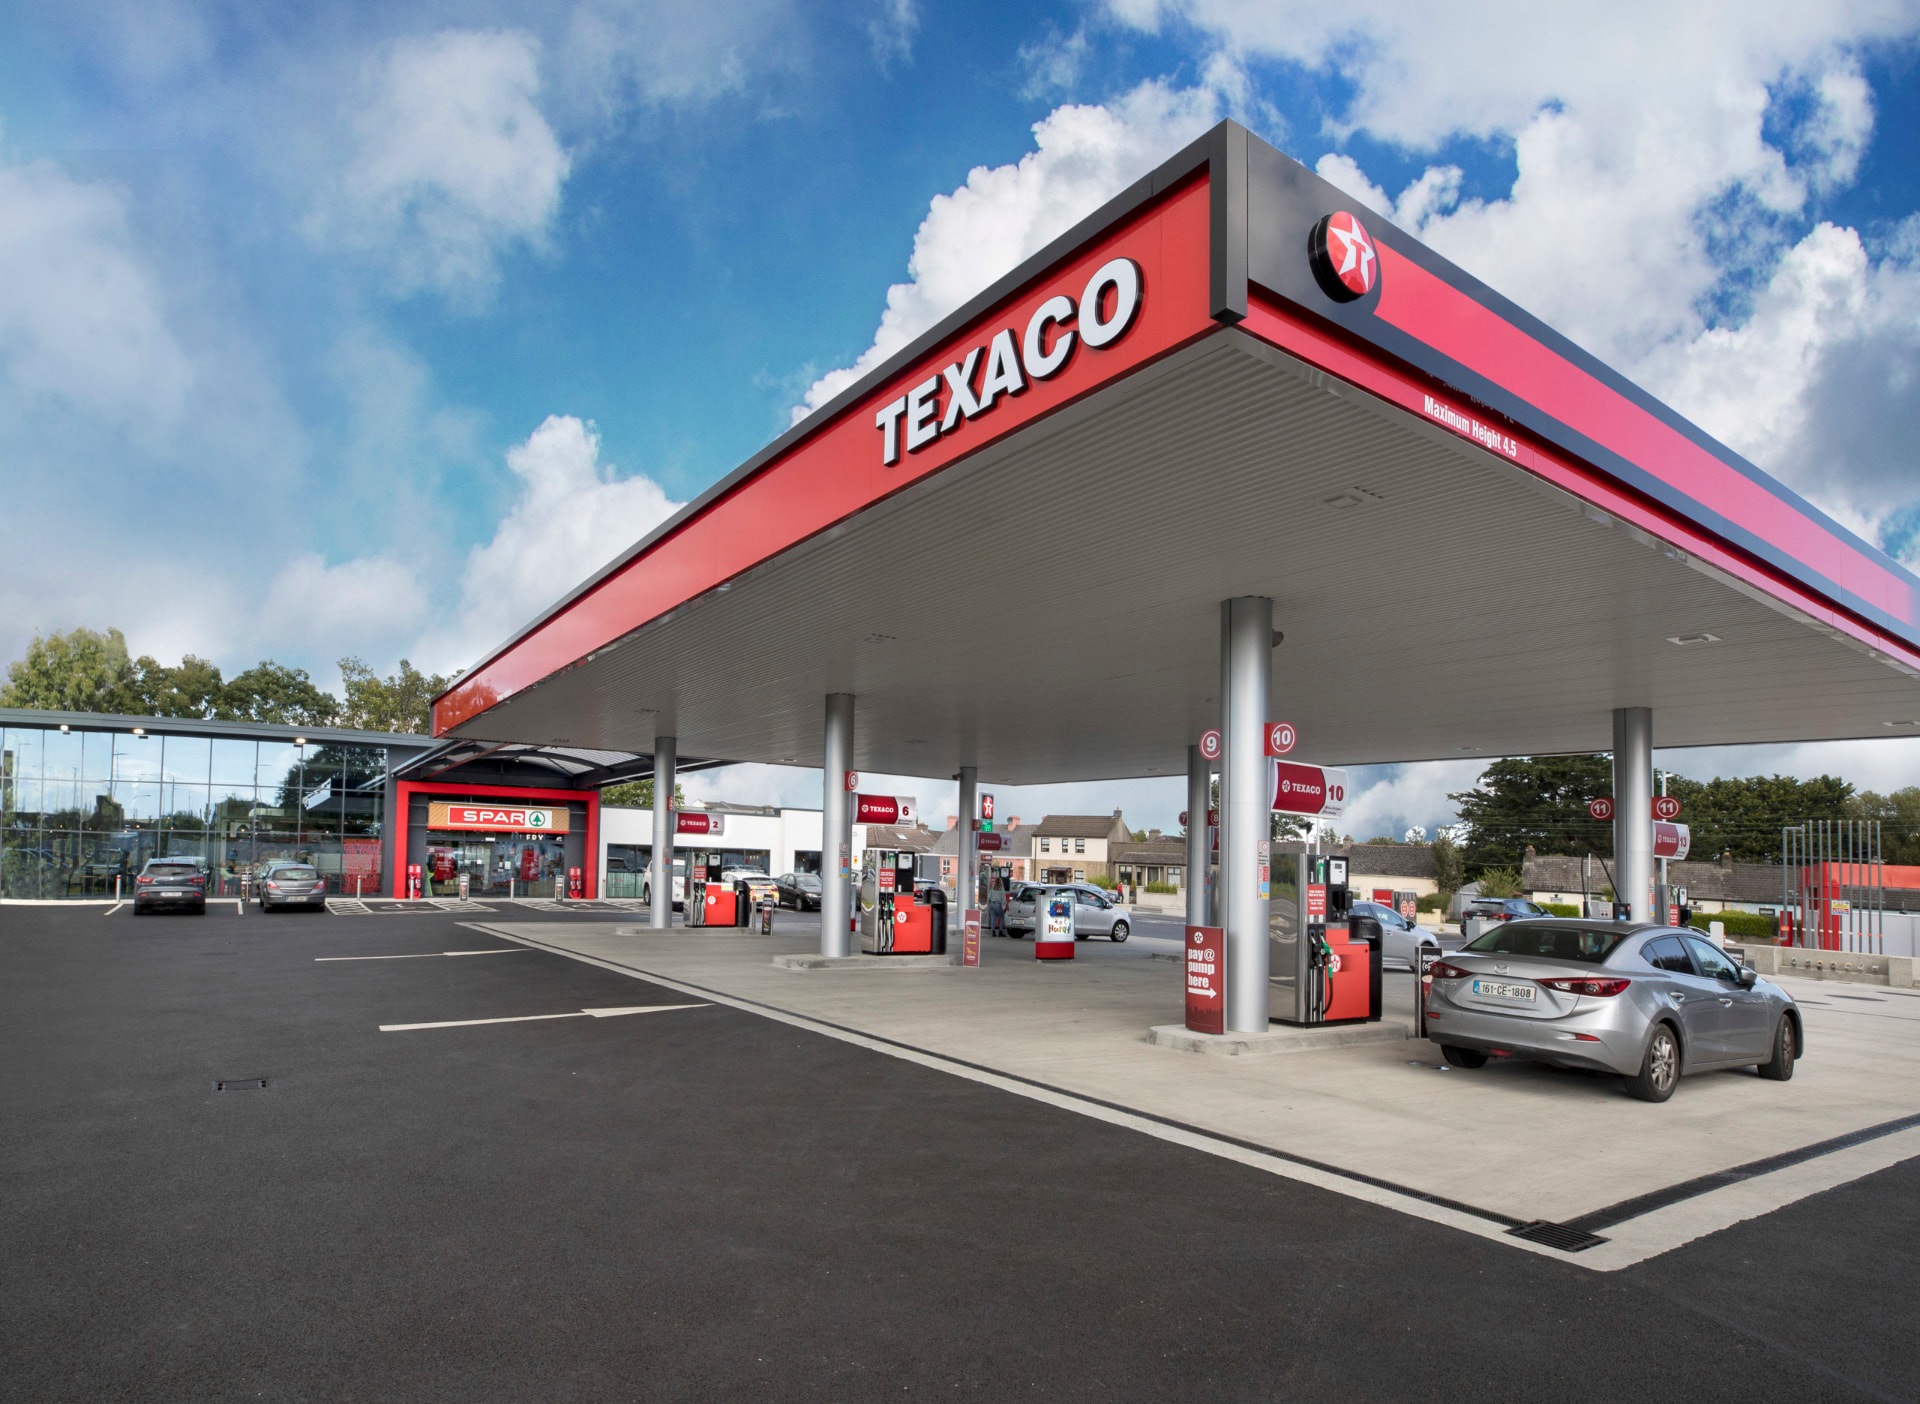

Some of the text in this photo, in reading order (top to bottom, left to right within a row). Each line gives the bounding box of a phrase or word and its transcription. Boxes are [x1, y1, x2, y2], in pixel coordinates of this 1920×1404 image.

[876, 257, 1143, 466] TEXACO
[1424, 394, 1470, 434] Maximum
[1472, 419, 1501, 449] Height
[1503, 436, 1517, 457] 4.5
[1206, 736, 1217, 752] 9
[1273, 730, 1291, 746] 10
[1292, 782, 1344, 802] TEXACO 10
[870, 805, 910, 816] TEXACO 6
[1594, 803, 1607, 814] 11
[1660, 803, 1674, 813] 11
[463, 810, 525, 824] SPAR
[1181, 814, 1187, 823] 7
[1213, 814, 1219, 823] 8
[712, 820, 719, 829] 2
[1662, 835, 1687, 848] TEXACO 13
[1188, 961, 1215, 975] pump
[1188, 973, 1210, 988] here
[1482, 983, 1531, 999] 161-CE-1808
